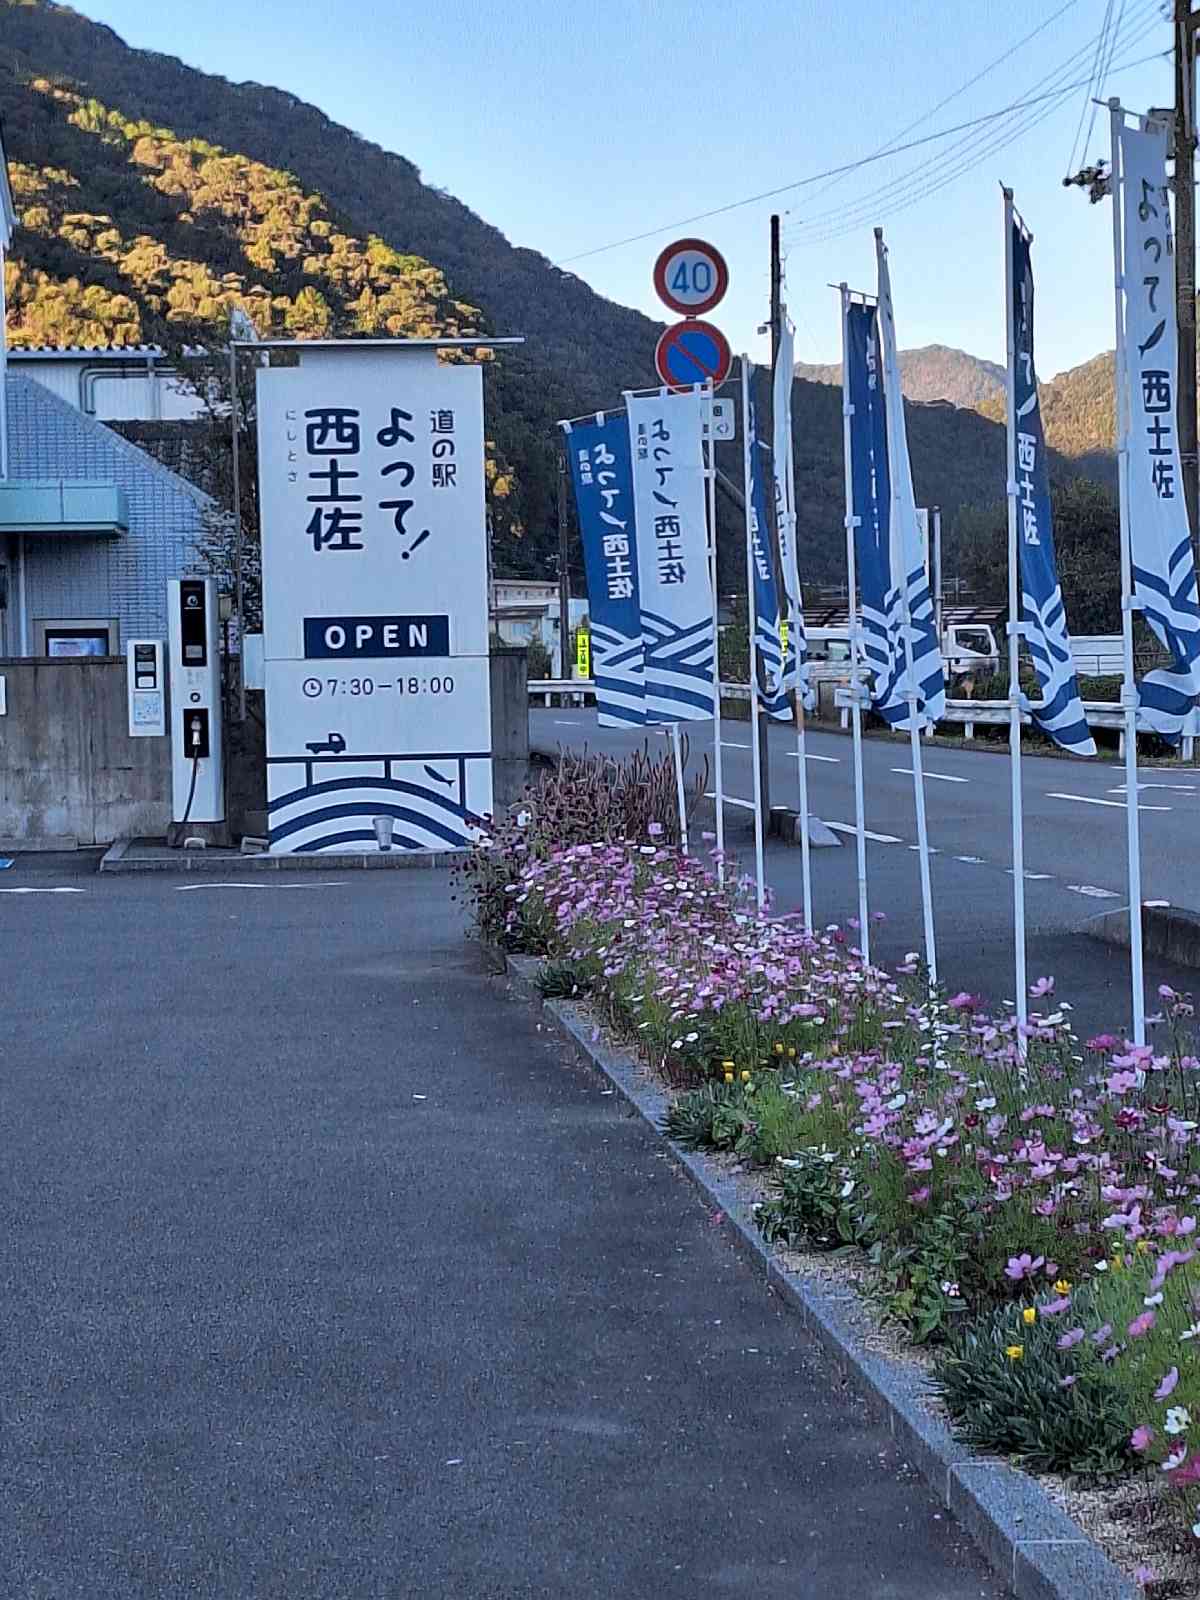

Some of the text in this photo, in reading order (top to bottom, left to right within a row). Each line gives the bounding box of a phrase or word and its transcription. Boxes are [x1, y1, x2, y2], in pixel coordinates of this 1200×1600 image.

[671, 262, 711, 294] 40
[285, 409, 297, 483] にしとさ
[430, 409, 457, 488] 道の駅
[1141, 370, 1175, 499] 西土佐
[304, 407, 364, 552] 西土佐
[324, 623, 428, 649] OPEN
